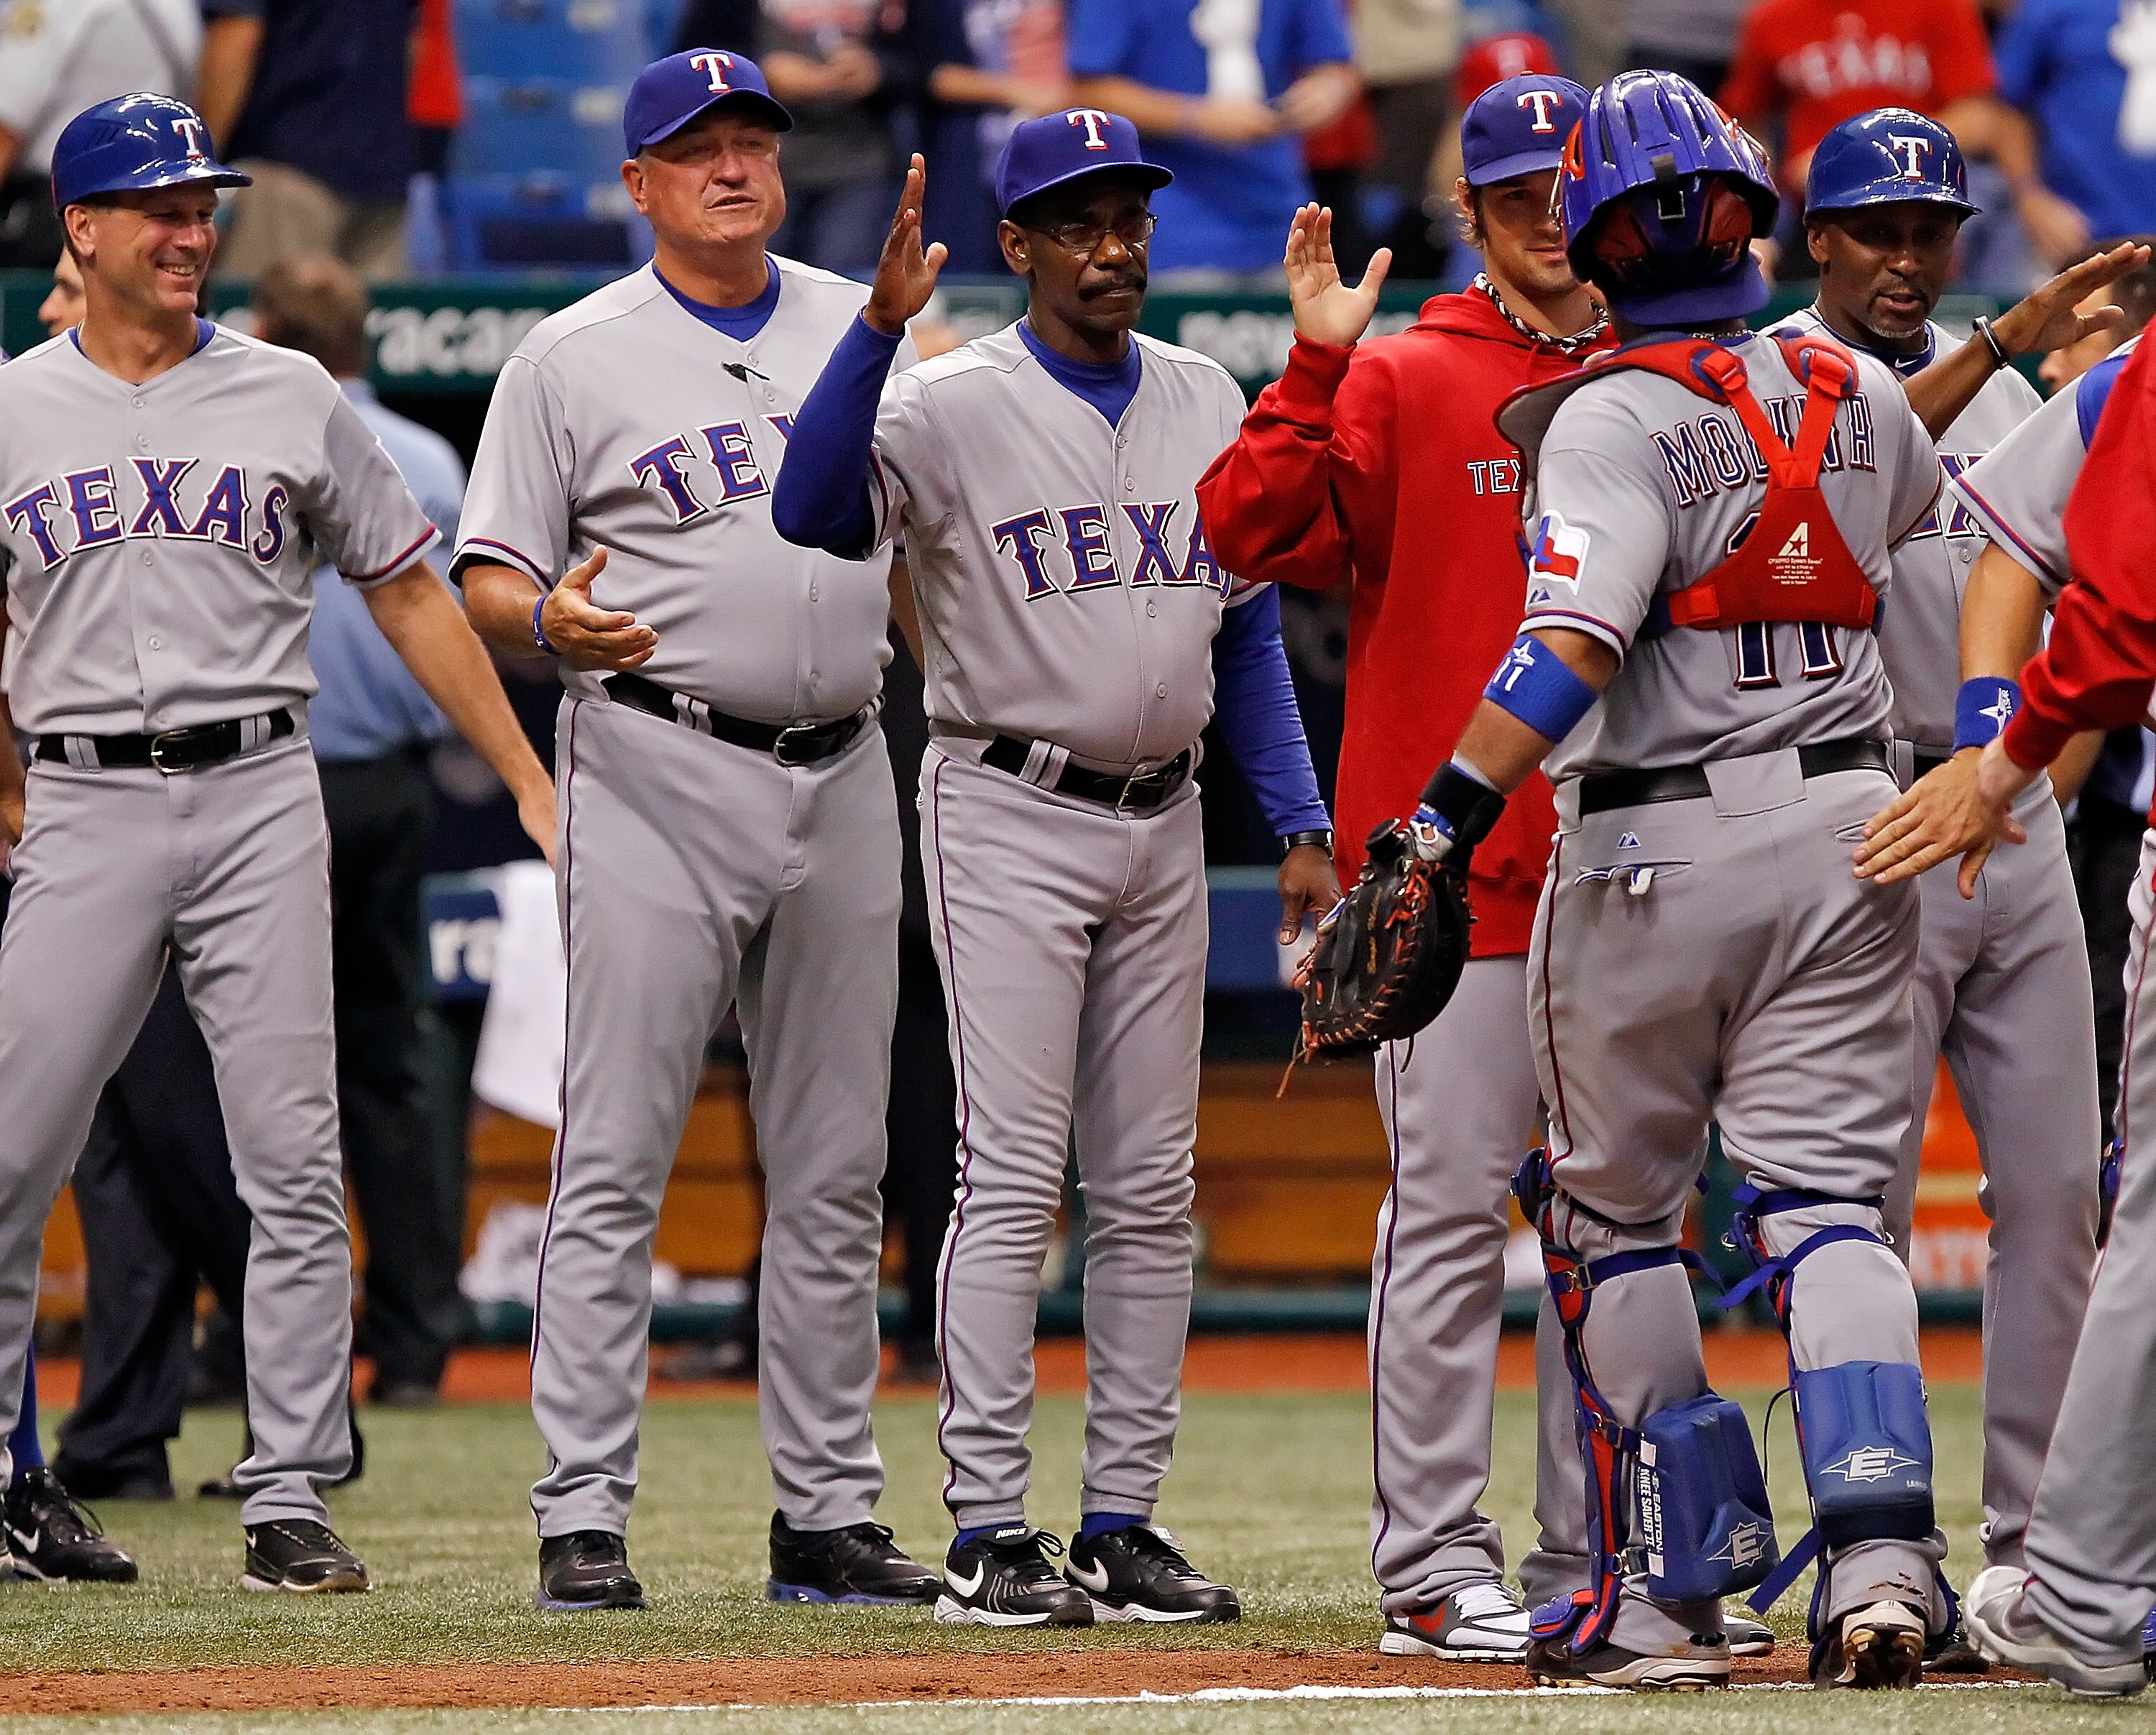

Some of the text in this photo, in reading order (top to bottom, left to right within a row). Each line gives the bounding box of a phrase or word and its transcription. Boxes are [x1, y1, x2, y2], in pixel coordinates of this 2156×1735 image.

[690, 53, 734, 93] T
[1066, 109, 1110, 150] T
[1516, 91, 1562, 133] T
[171, 119, 204, 160] T
[1892, 136, 1933, 180] T
[1, 456, 289, 572] TEXAS
[989, 499, 1233, 602] TEXA
[1641, 1469, 1651, 1496] KNEE
[995, 1527, 1027, 1540] NIKE
[1641, 1496, 1654, 1532] SAVER
[1654, 1494, 1663, 1551] EASTON
